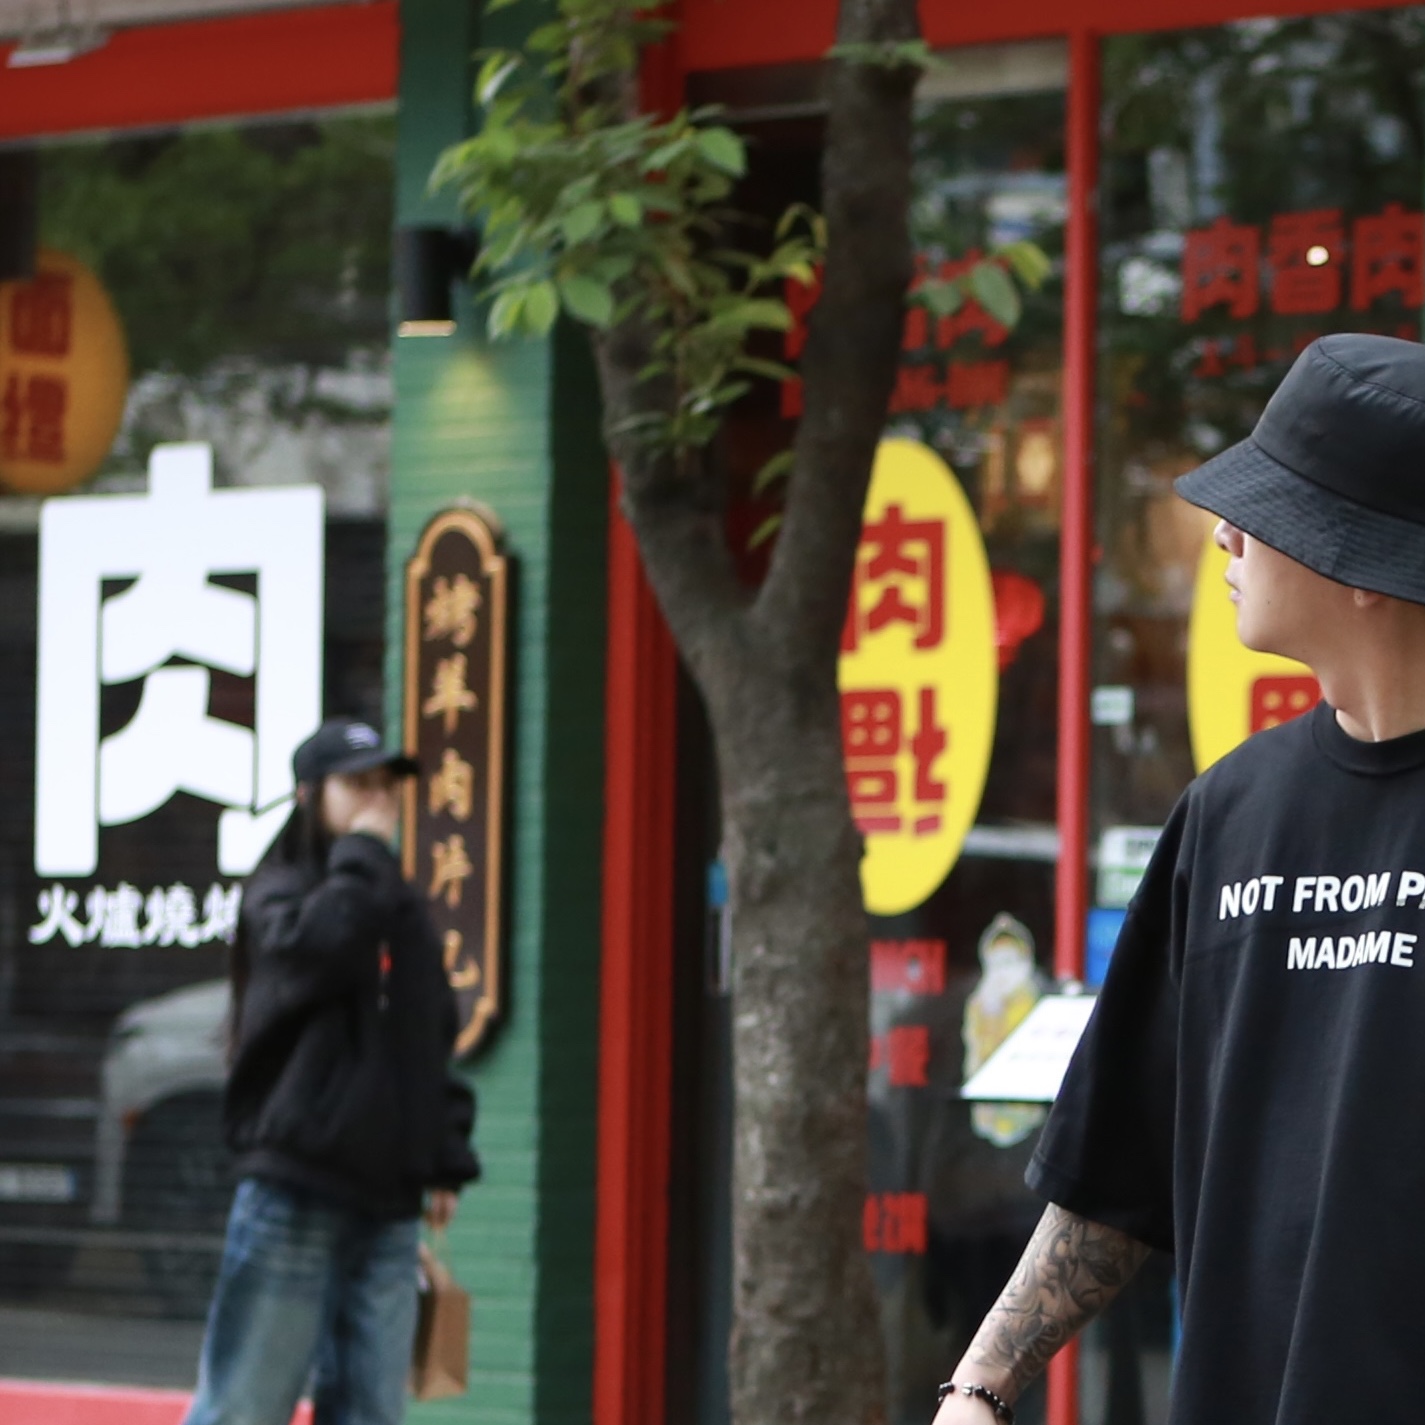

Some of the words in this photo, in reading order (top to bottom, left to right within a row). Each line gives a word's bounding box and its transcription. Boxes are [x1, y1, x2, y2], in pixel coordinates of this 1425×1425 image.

[35, 442, 324, 877] 肉
[1218, 875, 1284, 921] NOT
[1292, 871, 1392, 913] FROM
[1286, 930, 1418, 970] MADAME
